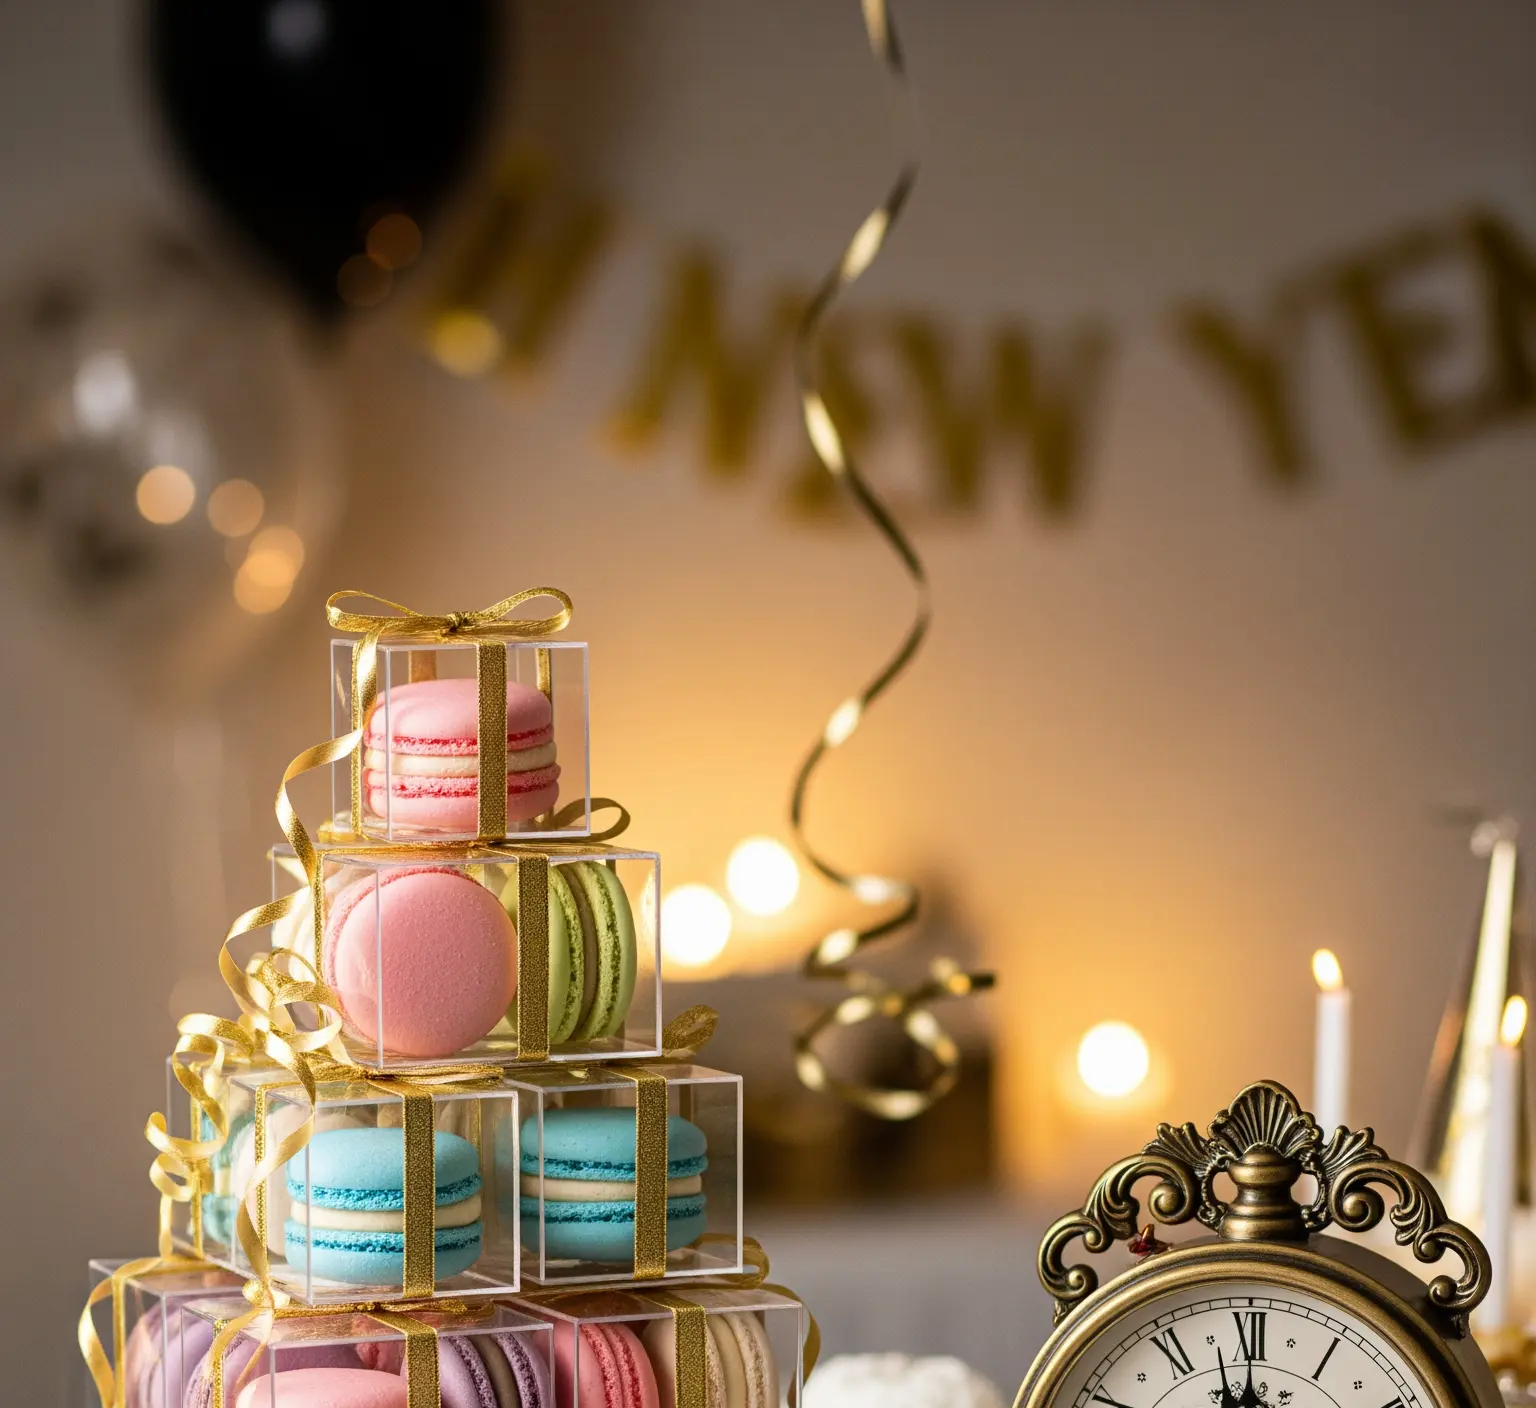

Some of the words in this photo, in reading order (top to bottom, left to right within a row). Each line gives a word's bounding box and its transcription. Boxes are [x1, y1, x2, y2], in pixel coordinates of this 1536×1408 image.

[1149, 1327, 1195, 1381] XI
[1232, 1312, 1267, 1362] XII
[1312, 1337, 1341, 1381] I
